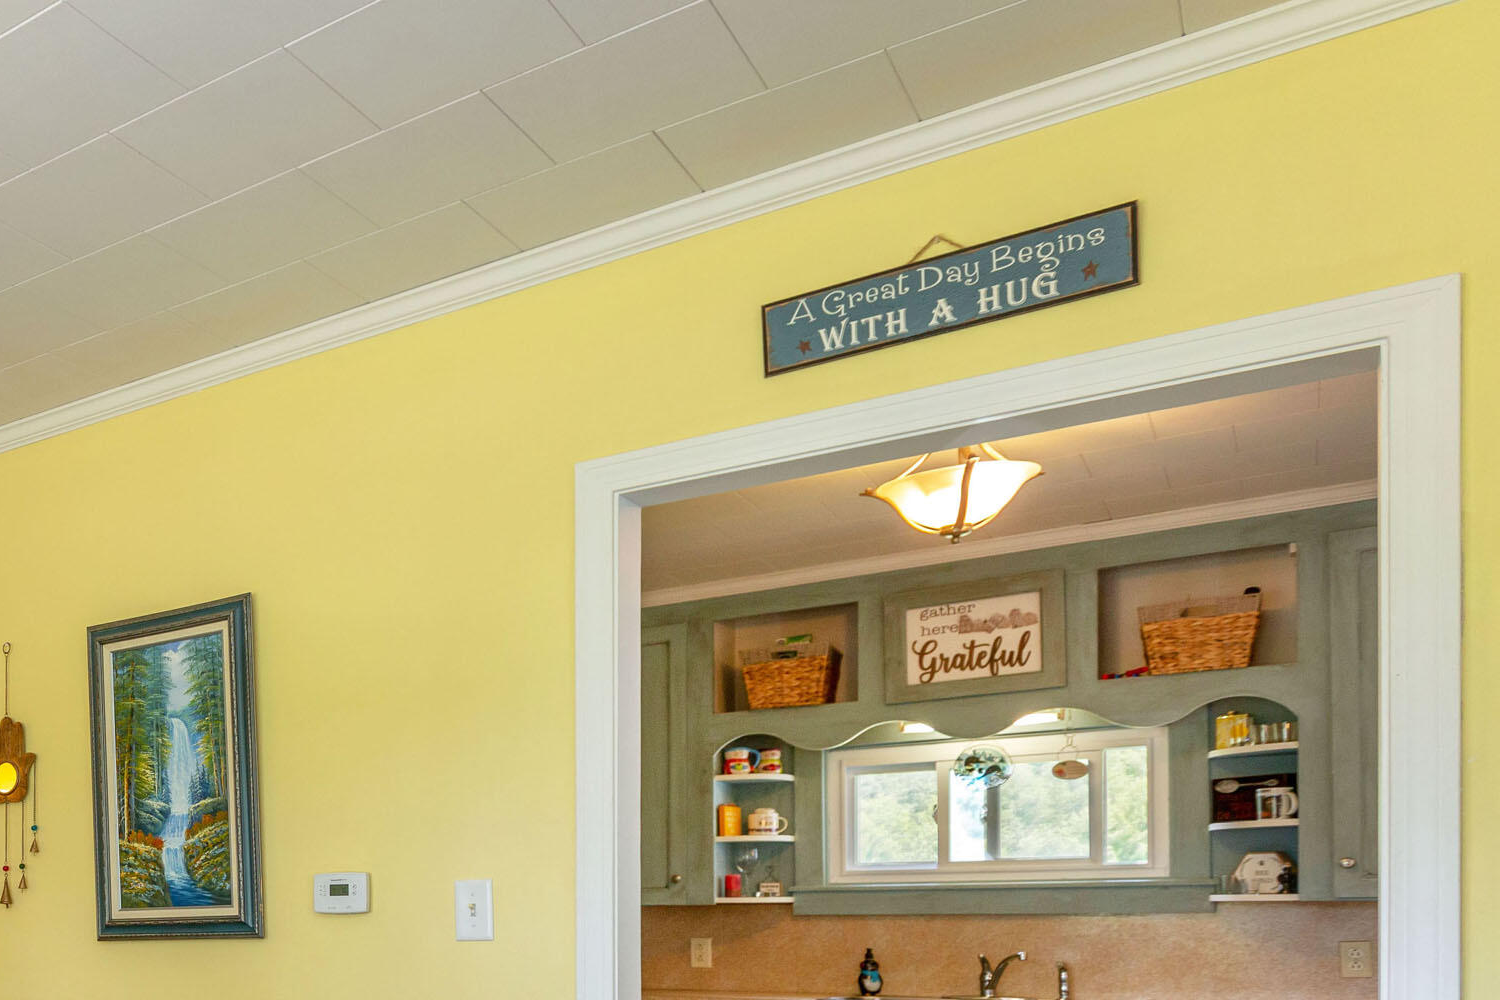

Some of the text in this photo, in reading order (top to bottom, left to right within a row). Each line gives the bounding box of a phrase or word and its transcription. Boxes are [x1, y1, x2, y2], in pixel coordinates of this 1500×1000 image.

[787, 227, 1106, 326] A Great Day Begins
[819, 271, 1060, 352] WITH A HUG
[919, 603, 975, 621] gather
[921, 625, 958, 636] here
[912, 631, 1031, 684] Grateful
